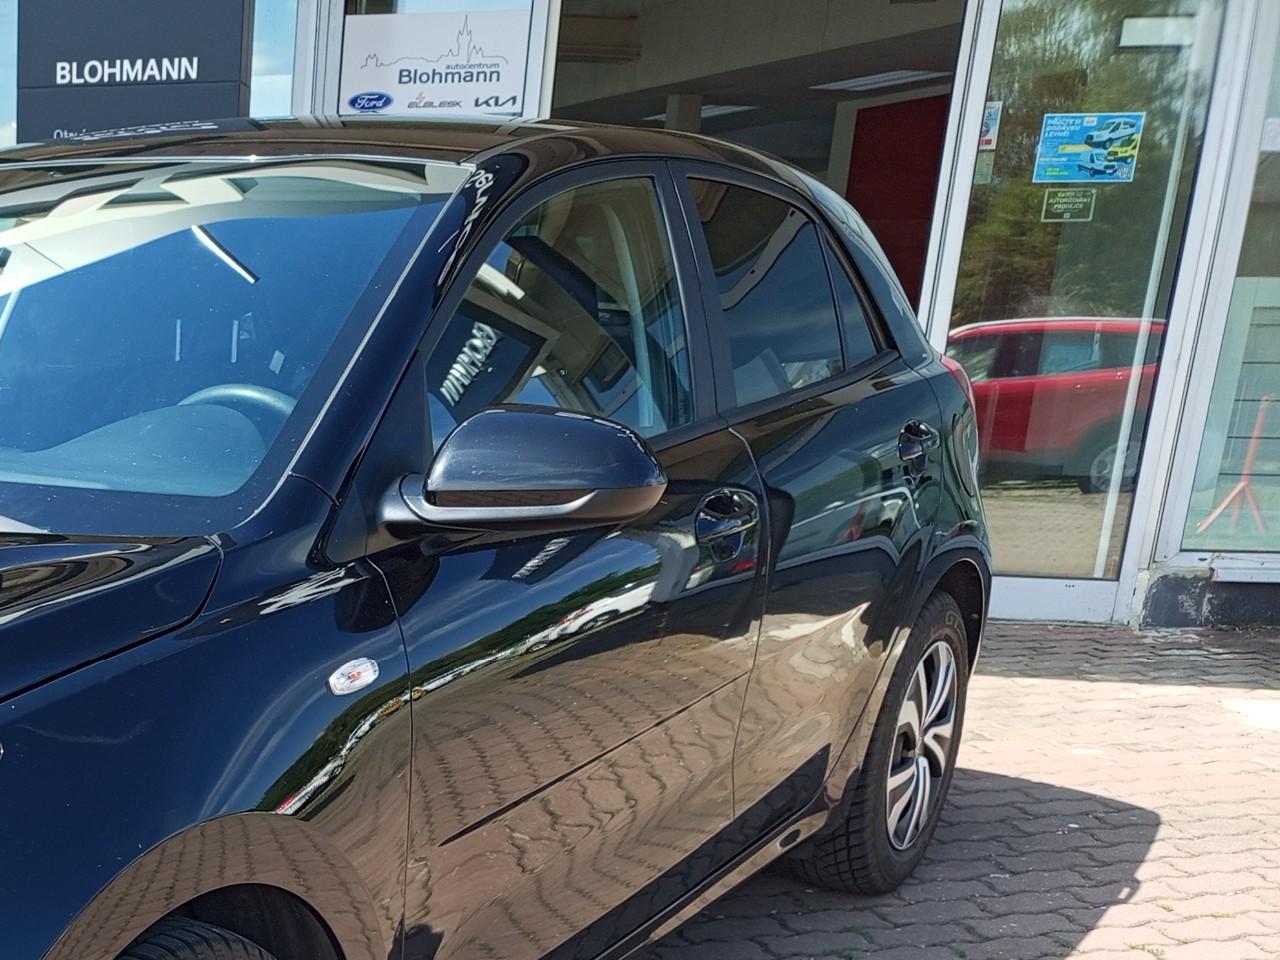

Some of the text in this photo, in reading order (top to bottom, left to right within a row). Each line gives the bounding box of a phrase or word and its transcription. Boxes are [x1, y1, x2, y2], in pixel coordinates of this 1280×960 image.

[55, 56, 199, 84] BLOHMANN
[445, 62, 500, 70] autocentrum
[398, 69, 500, 84] Blohmann
[474, 95, 518, 108] KIA
